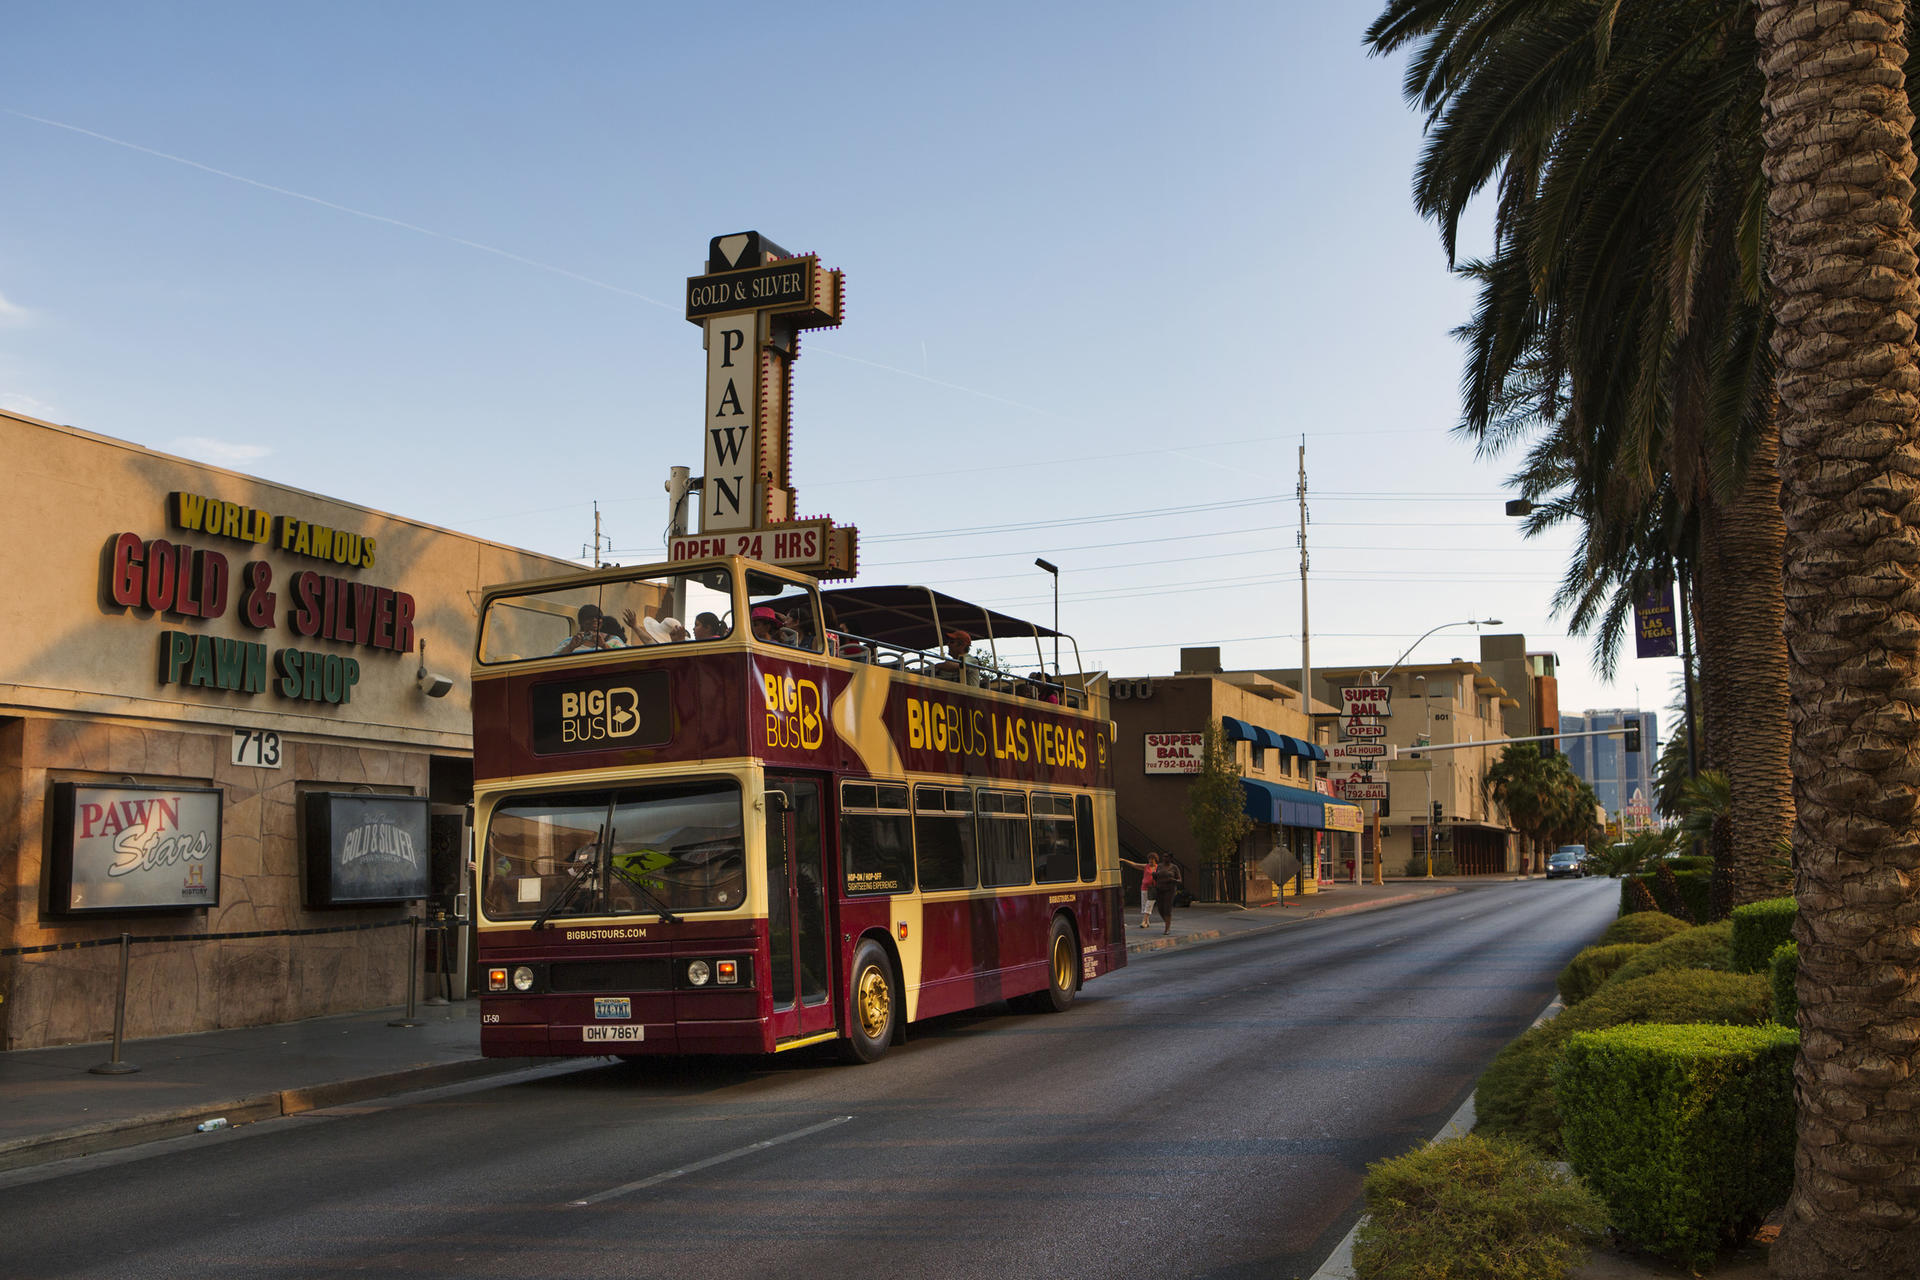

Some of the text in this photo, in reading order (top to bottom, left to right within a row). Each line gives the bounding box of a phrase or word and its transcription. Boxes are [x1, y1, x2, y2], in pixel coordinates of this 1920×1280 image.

[691, 272, 801, 307] GOLD & SILVER
[710, 328, 749, 517] PAWN
[180, 492, 377, 569] WORLD FAMOUS
[737, 535, 763, 561] 24
[774, 530, 817, 560] HRS
[112, 532, 416, 653] GOLD & SILVER
[1641, 626, 1673, 639] VEGAS
[1642, 618, 1663, 630] LAS
[171, 630, 360, 704] PAWN SHOP
[562, 690, 605, 718] BIG
[764, 673, 798, 712] BIG
[1344, 689, 1387, 702] SUPER
[1351, 702, 1381, 716] BAIL
[562, 716, 606, 743] BUS
[766, 711, 800, 749] BUS
[991, 712, 1029, 763] LAS
[1031, 719, 1087, 770] VEGAS
[1148, 734, 1202, 747] SUPER
[1350, 727, 1382, 735] OPEN
[235, 729, 281, 766] 713
[1157, 747, 1194, 758] BAIL
[1359, 747, 1383, 755] HOURS
[1347, 790, 1386, 798] 792-BAIL
[79, 797, 181, 839] PAWN
[107, 823, 212, 878] Stars
[341, 823, 418, 871] GOLD & SILVER
[181, 887, 208, 896] HISTORY
[566, 927, 647, 940] BIGBUSTOURS.COM
[483, 1014, 500, 1023] LT-50
[587, 1027, 638, 1039] OHV 786Y
